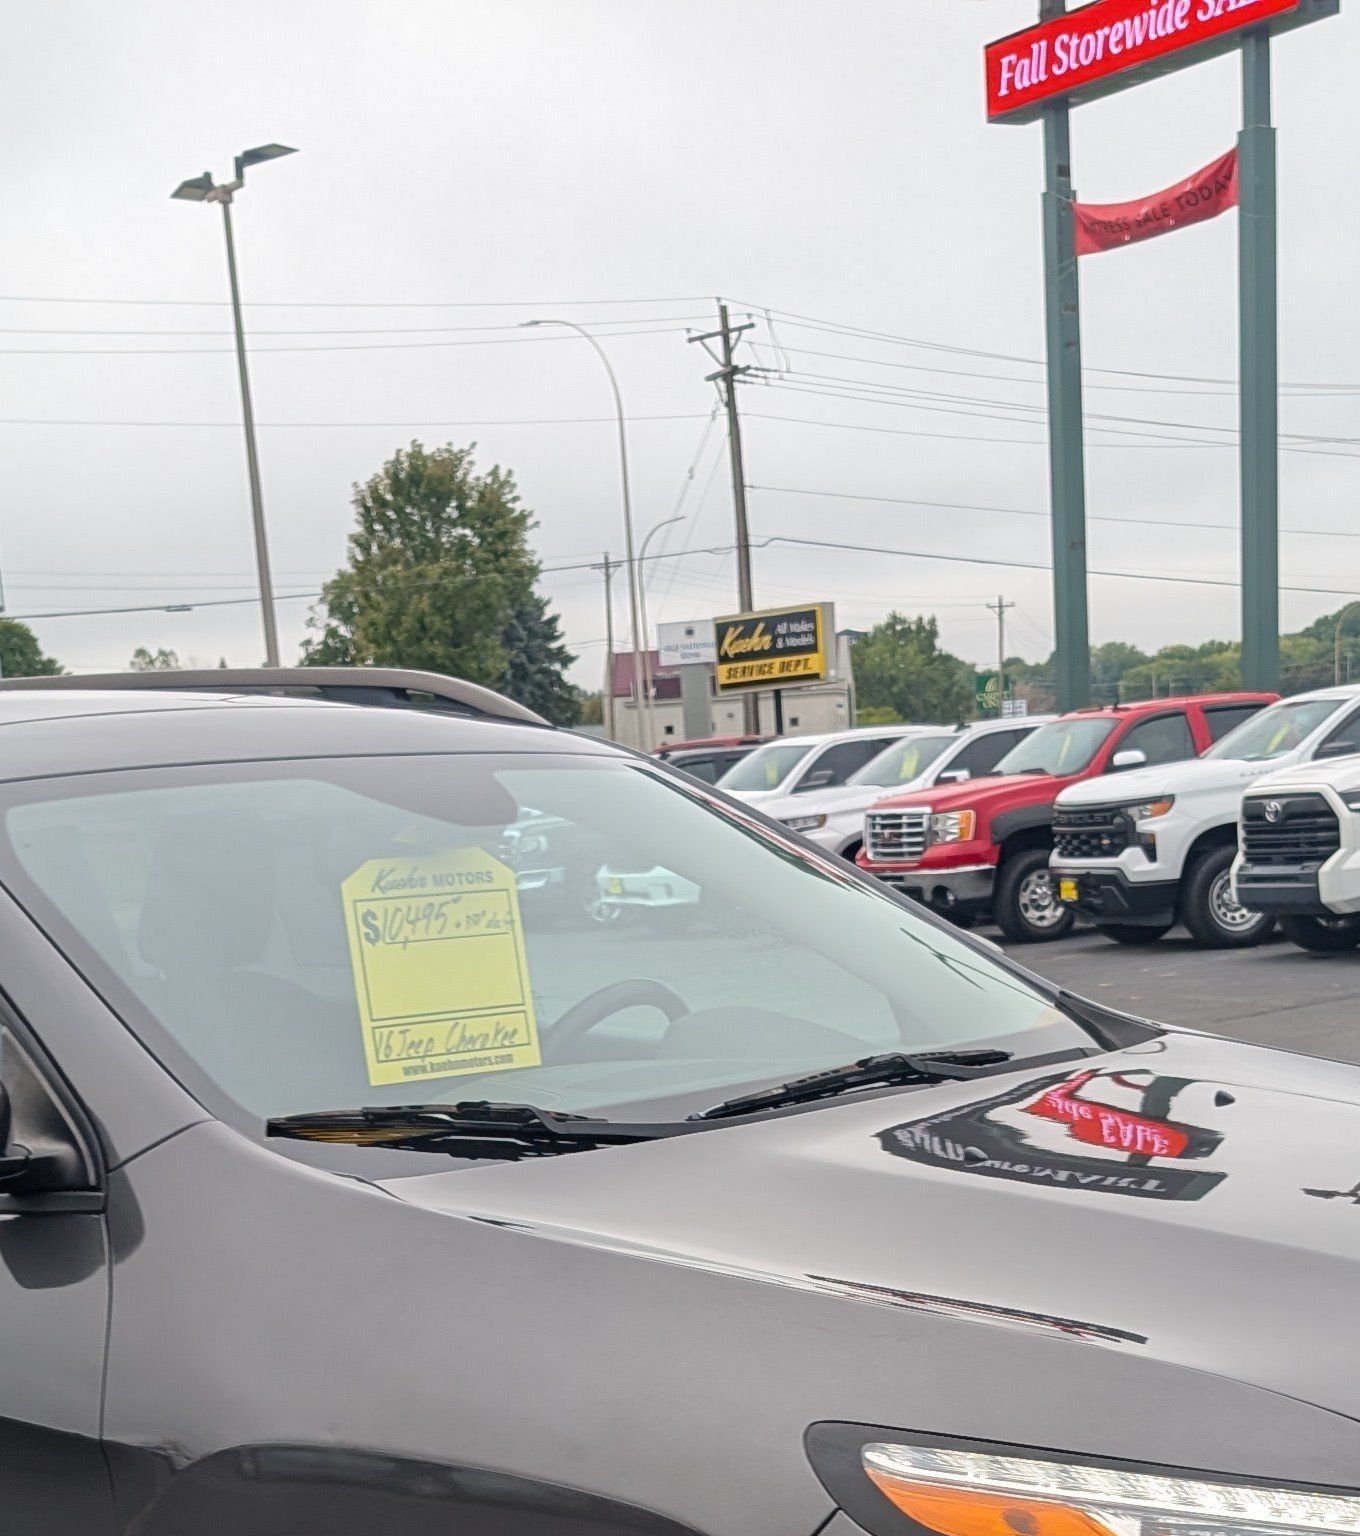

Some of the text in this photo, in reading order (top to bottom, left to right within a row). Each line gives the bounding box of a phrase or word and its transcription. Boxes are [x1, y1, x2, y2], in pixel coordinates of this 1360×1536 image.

[997, 0, 1190, 97] Fall Storewide
[726, 662, 774, 680] SERVICE
[431, 871, 494, 888] MOTORS
